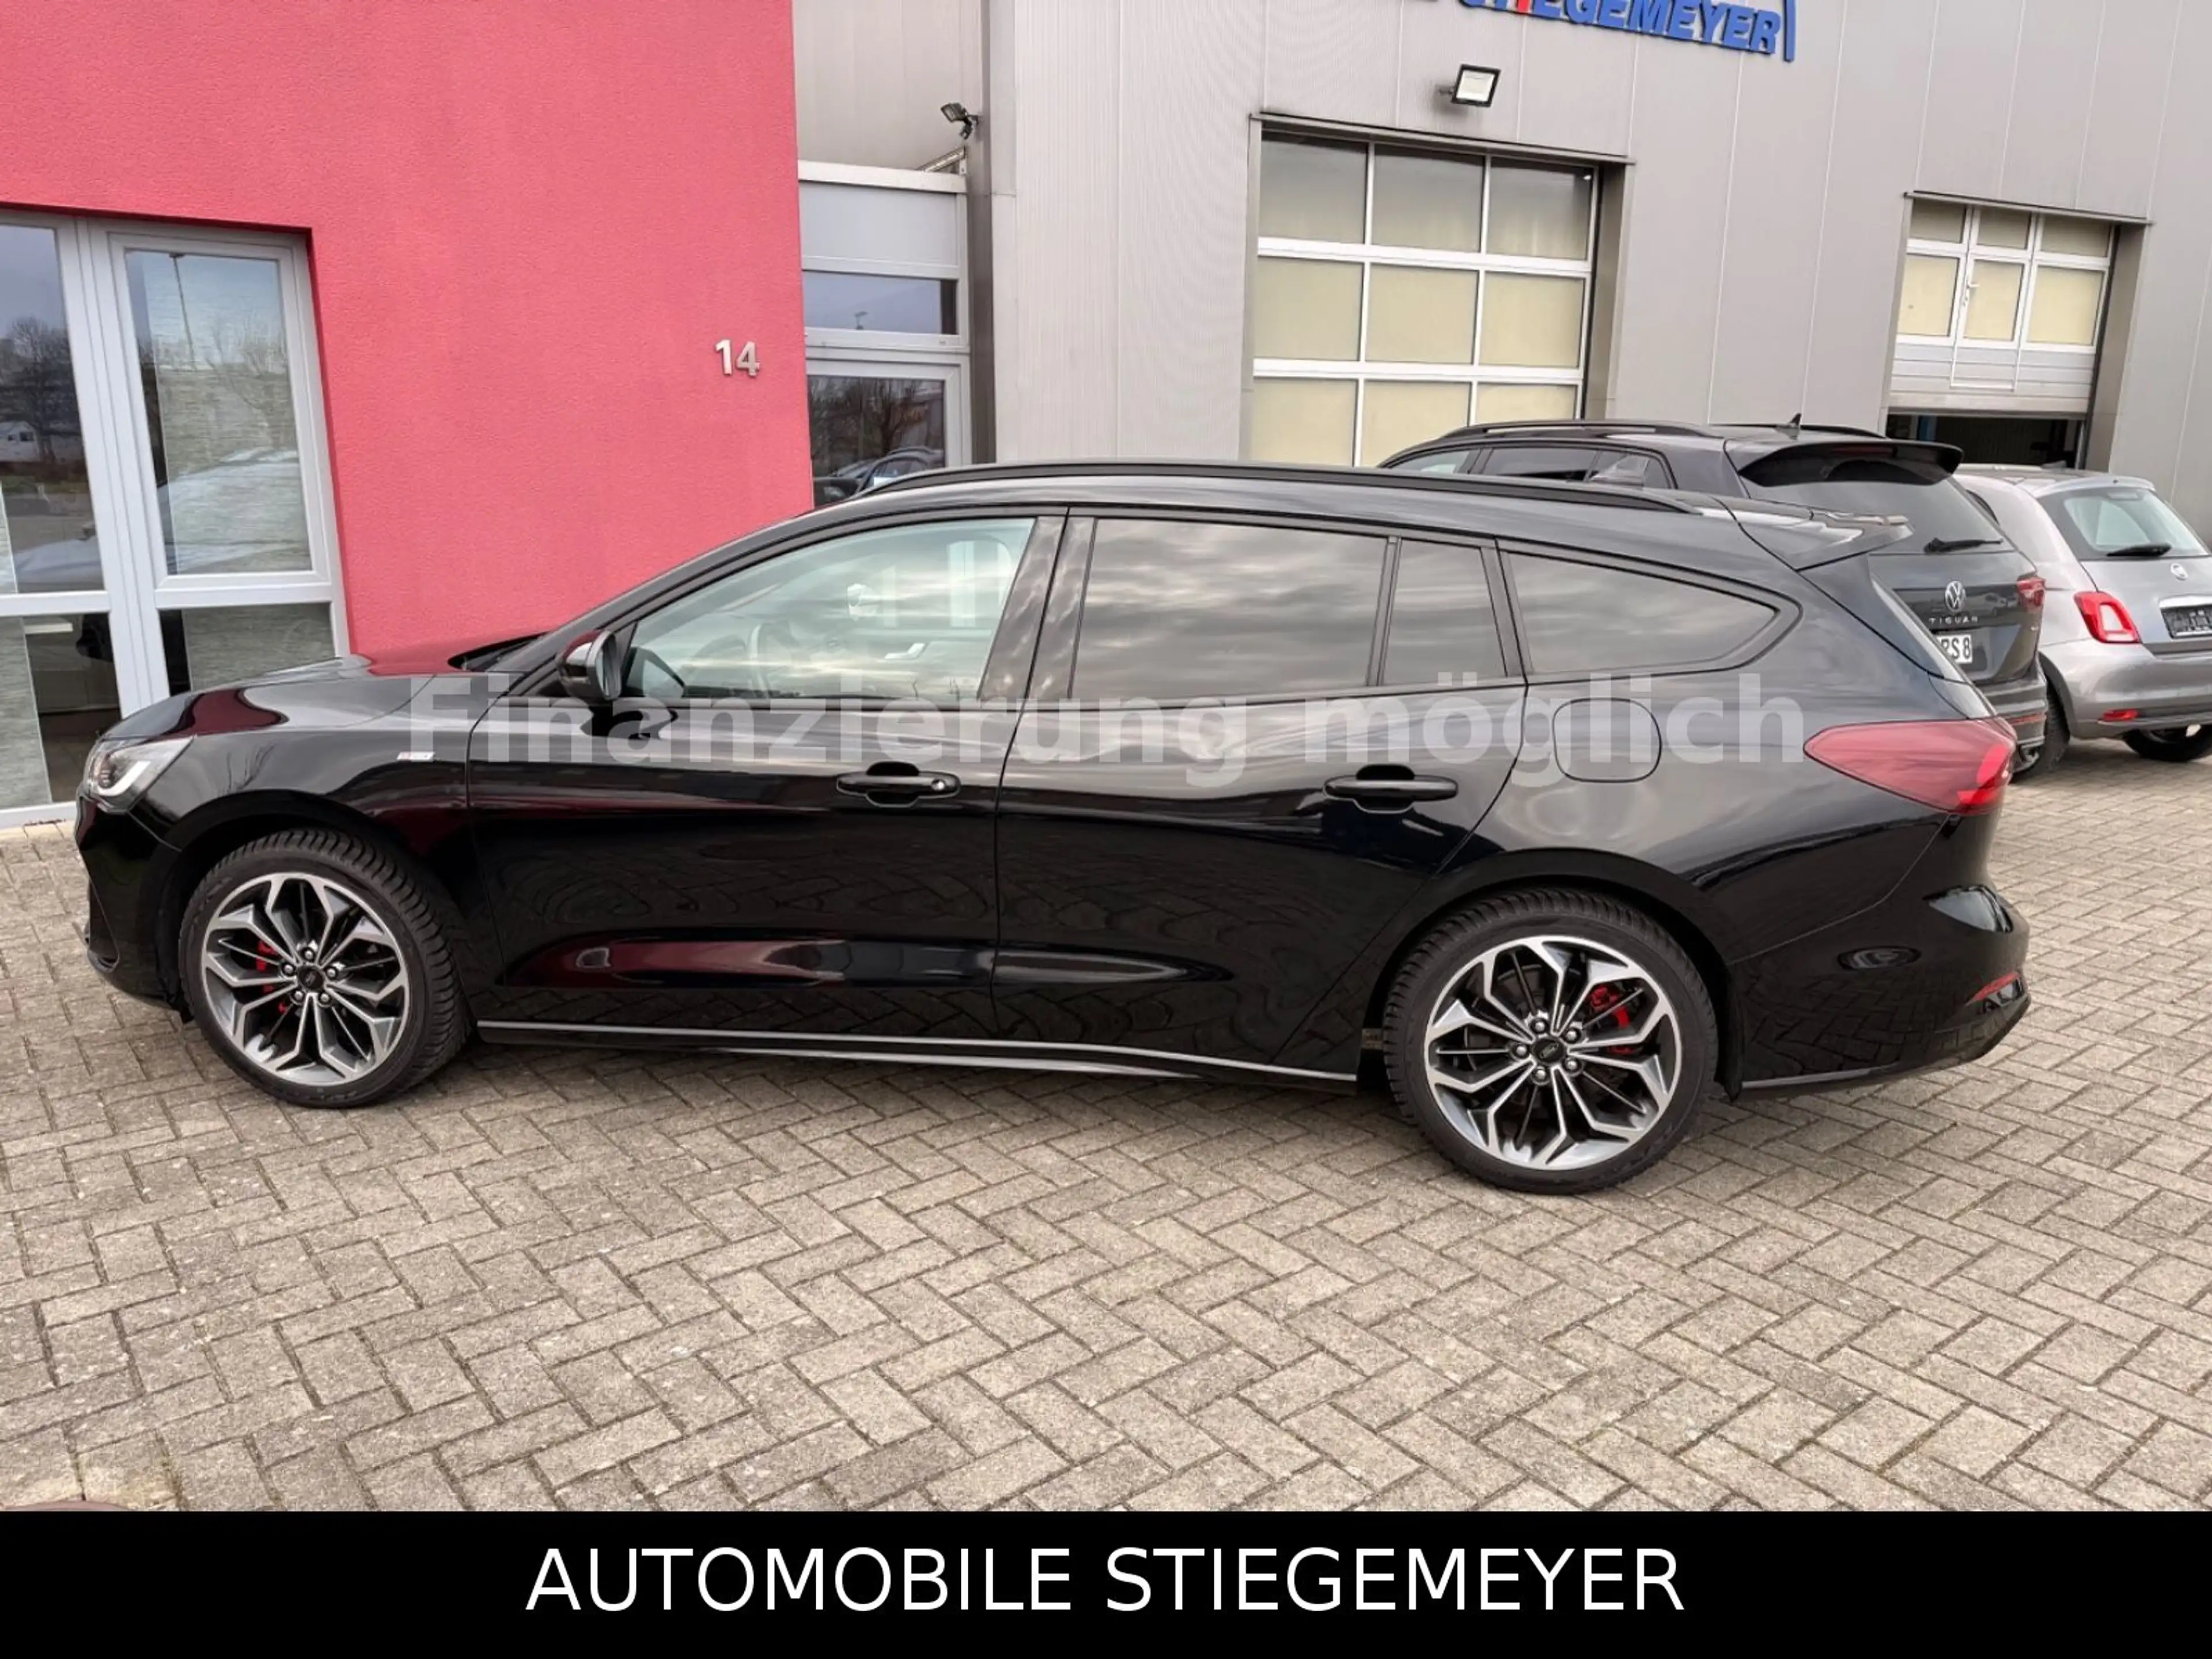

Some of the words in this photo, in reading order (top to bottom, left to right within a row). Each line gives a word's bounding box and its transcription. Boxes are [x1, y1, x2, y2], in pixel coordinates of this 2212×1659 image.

[1457, 0, 1781, 55] GEMEYER
[715, 339, 760, 377] 14
[1929, 616, 1978, 625] TIGUAN
[1963, 637, 1971, 659] 8
